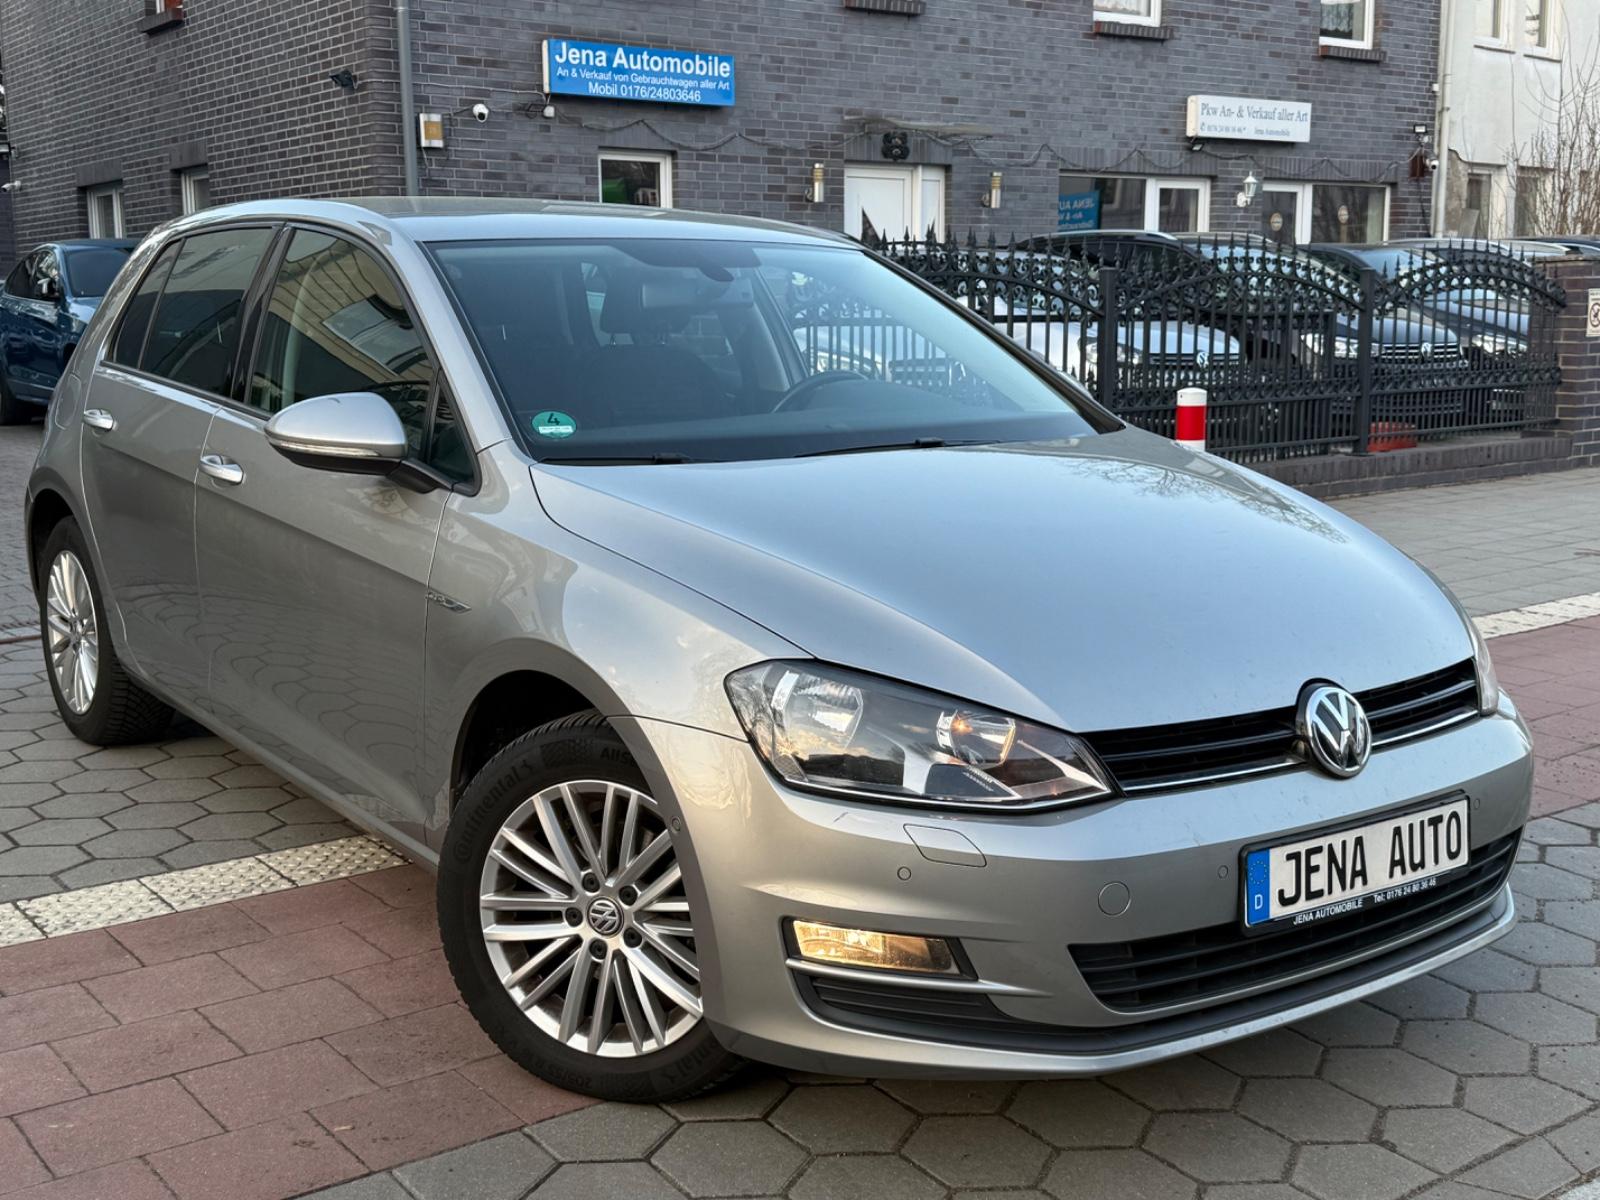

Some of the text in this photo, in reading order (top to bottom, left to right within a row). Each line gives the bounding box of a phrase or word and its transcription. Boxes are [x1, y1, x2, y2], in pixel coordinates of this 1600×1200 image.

[555, 42, 731, 77] Jena Automobile
[556, 67, 730, 91] An & Verkauf von Gebrauchtwagen aller Art
[588, 81, 701, 103] Mobil 0176/24803646
[1201, 103, 1219, 117] Pkw
[1236, 105, 1244, 118] &
[1246, 105, 1277, 121] Verkauf
[1278, 107, 1295, 121] aller
[1295, 109, 1308, 122] Art
[547, 412, 560, 425] 4
[1277, 810, 1462, 907] JENA AUTO
[1254, 893, 1263, 910] D
[1293, 912, 1314, 926] JENA
[1315, 899, 1364, 920] AUTOMOBILE
[1386, 887, 1403, 900] 0176
[1403, 885, 1412, 896] 24
